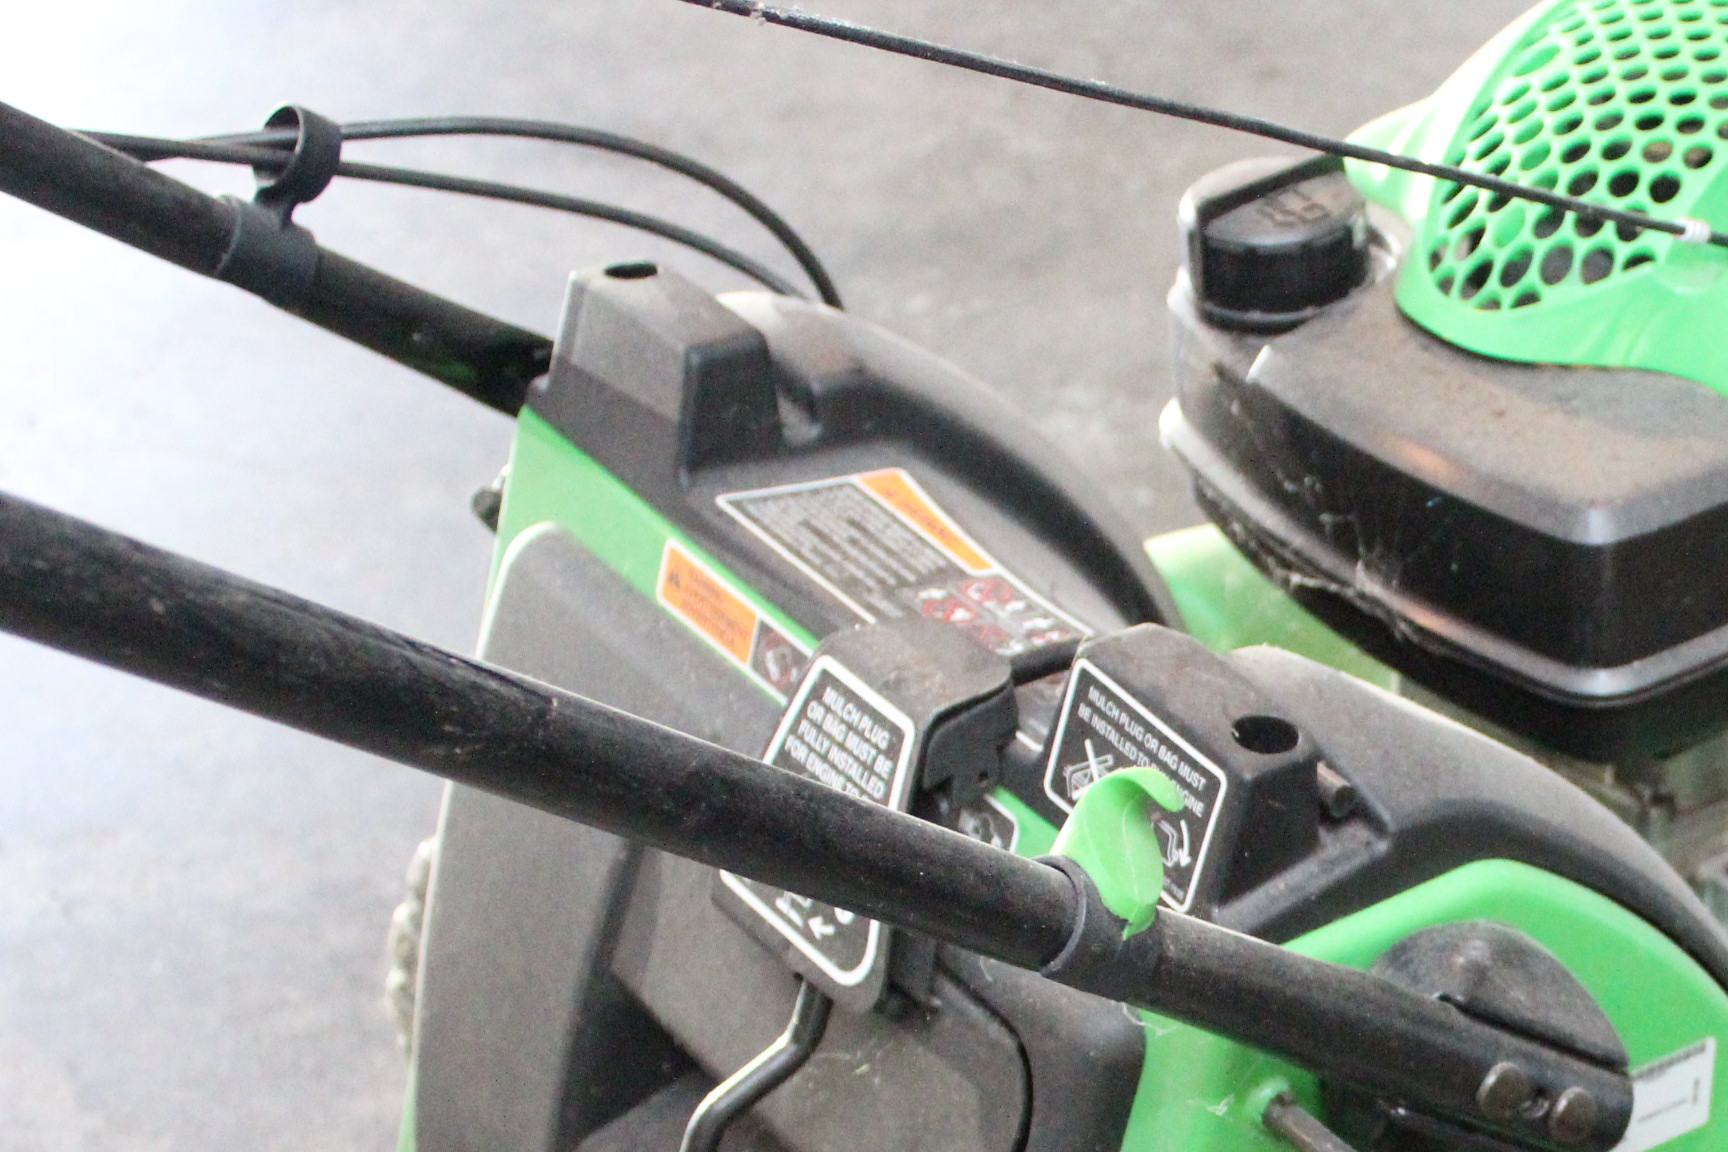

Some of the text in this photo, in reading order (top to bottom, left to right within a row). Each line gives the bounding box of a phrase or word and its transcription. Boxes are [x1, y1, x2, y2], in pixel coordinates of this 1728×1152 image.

[785, 734, 810, 765] FOR
[807, 701, 894, 780] OR BAG MUST BE
[822, 686, 891, 750] MULCH PLUG
[1077, 702, 1093, 723] BE
[1091, 715, 1137, 760] INSTALLED
[1136, 751, 1149, 768] TO
[1088, 686, 1120, 720] MULCH
[1119, 712, 1145, 744] PLUG
[1143, 733, 1160, 755] OR
[1158, 745, 1178, 770] BAG
[1177, 761, 1207, 791] MUST
[798, 719, 887, 799] FULLY INSTALLED
